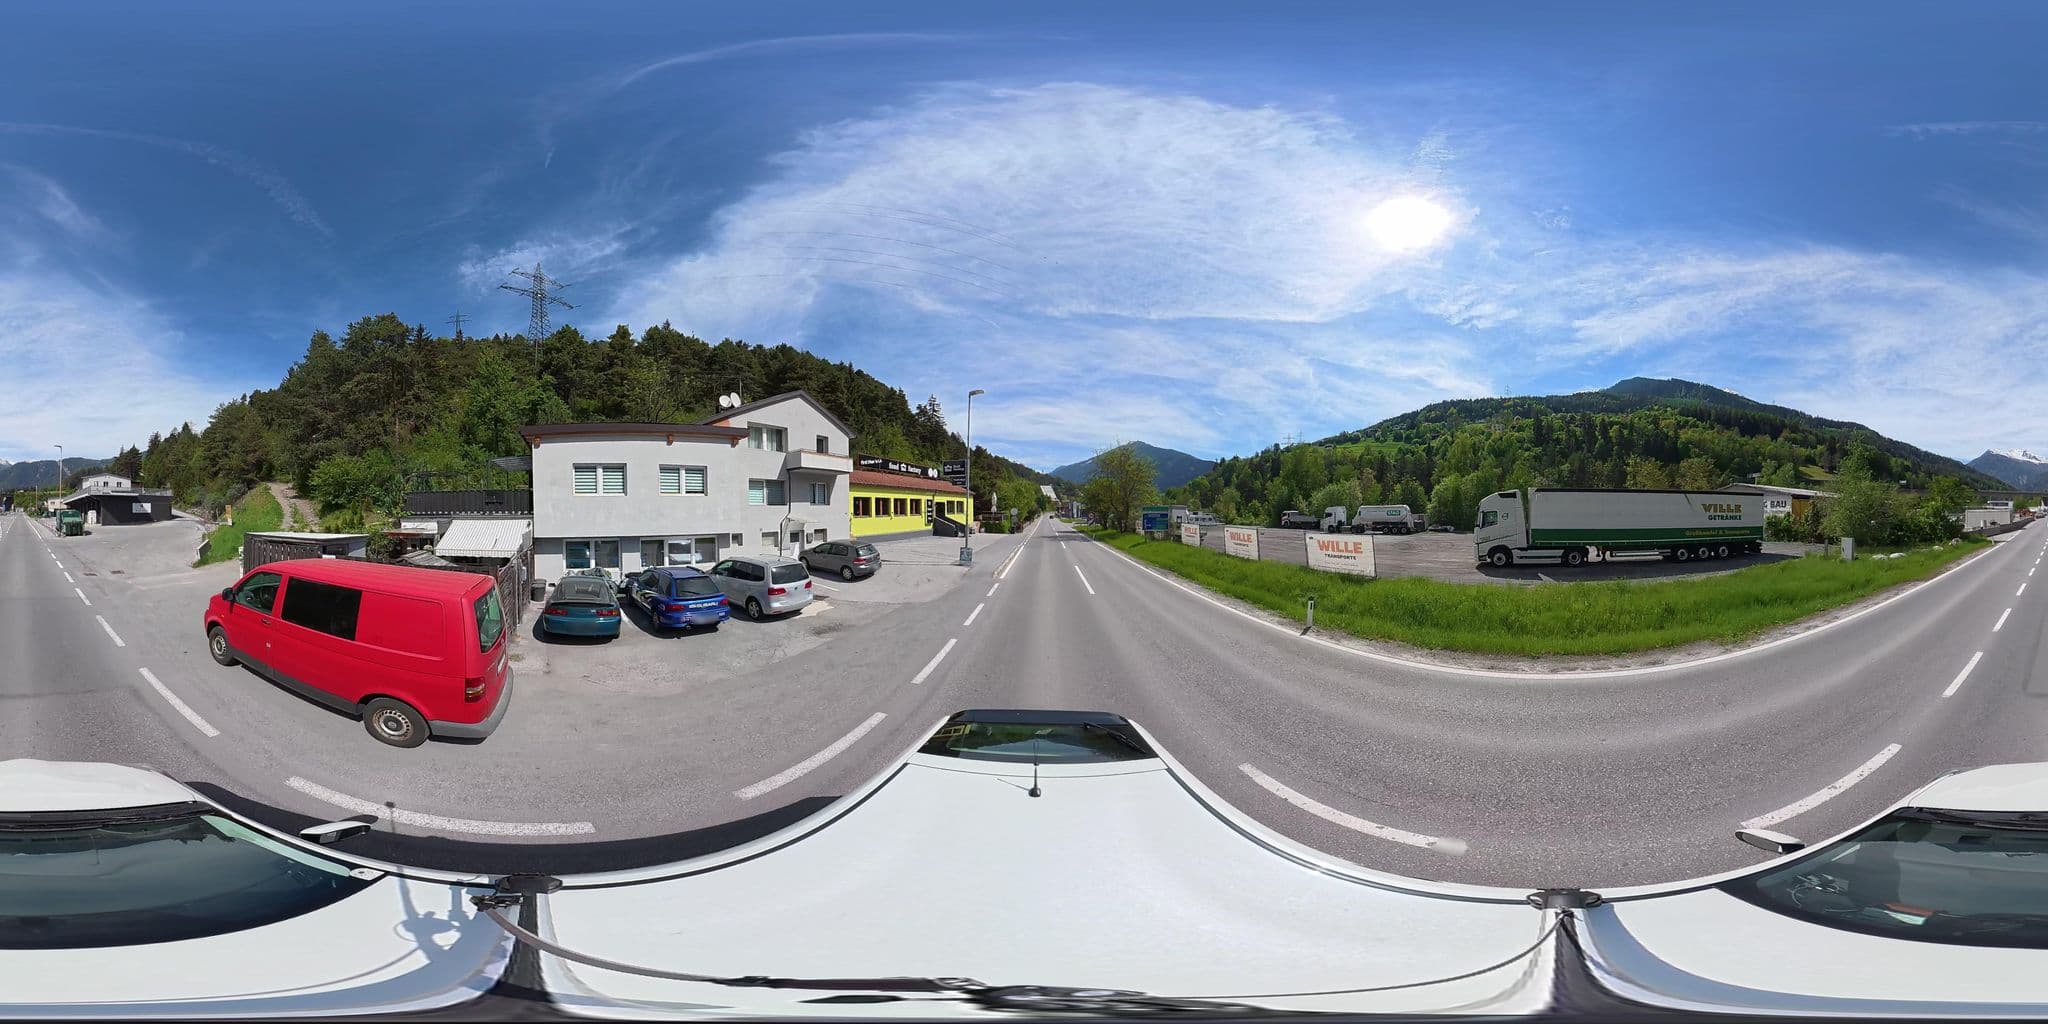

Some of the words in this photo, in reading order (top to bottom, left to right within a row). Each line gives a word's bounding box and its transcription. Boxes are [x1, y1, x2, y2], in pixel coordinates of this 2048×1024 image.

[1702, 504, 1742, 513] WILLE
[1229, 531, 1253, 543] WILLE
[1317, 540, 1363, 554] WILLE
[1324, 553, 1357, 561] TRANSPORTE
